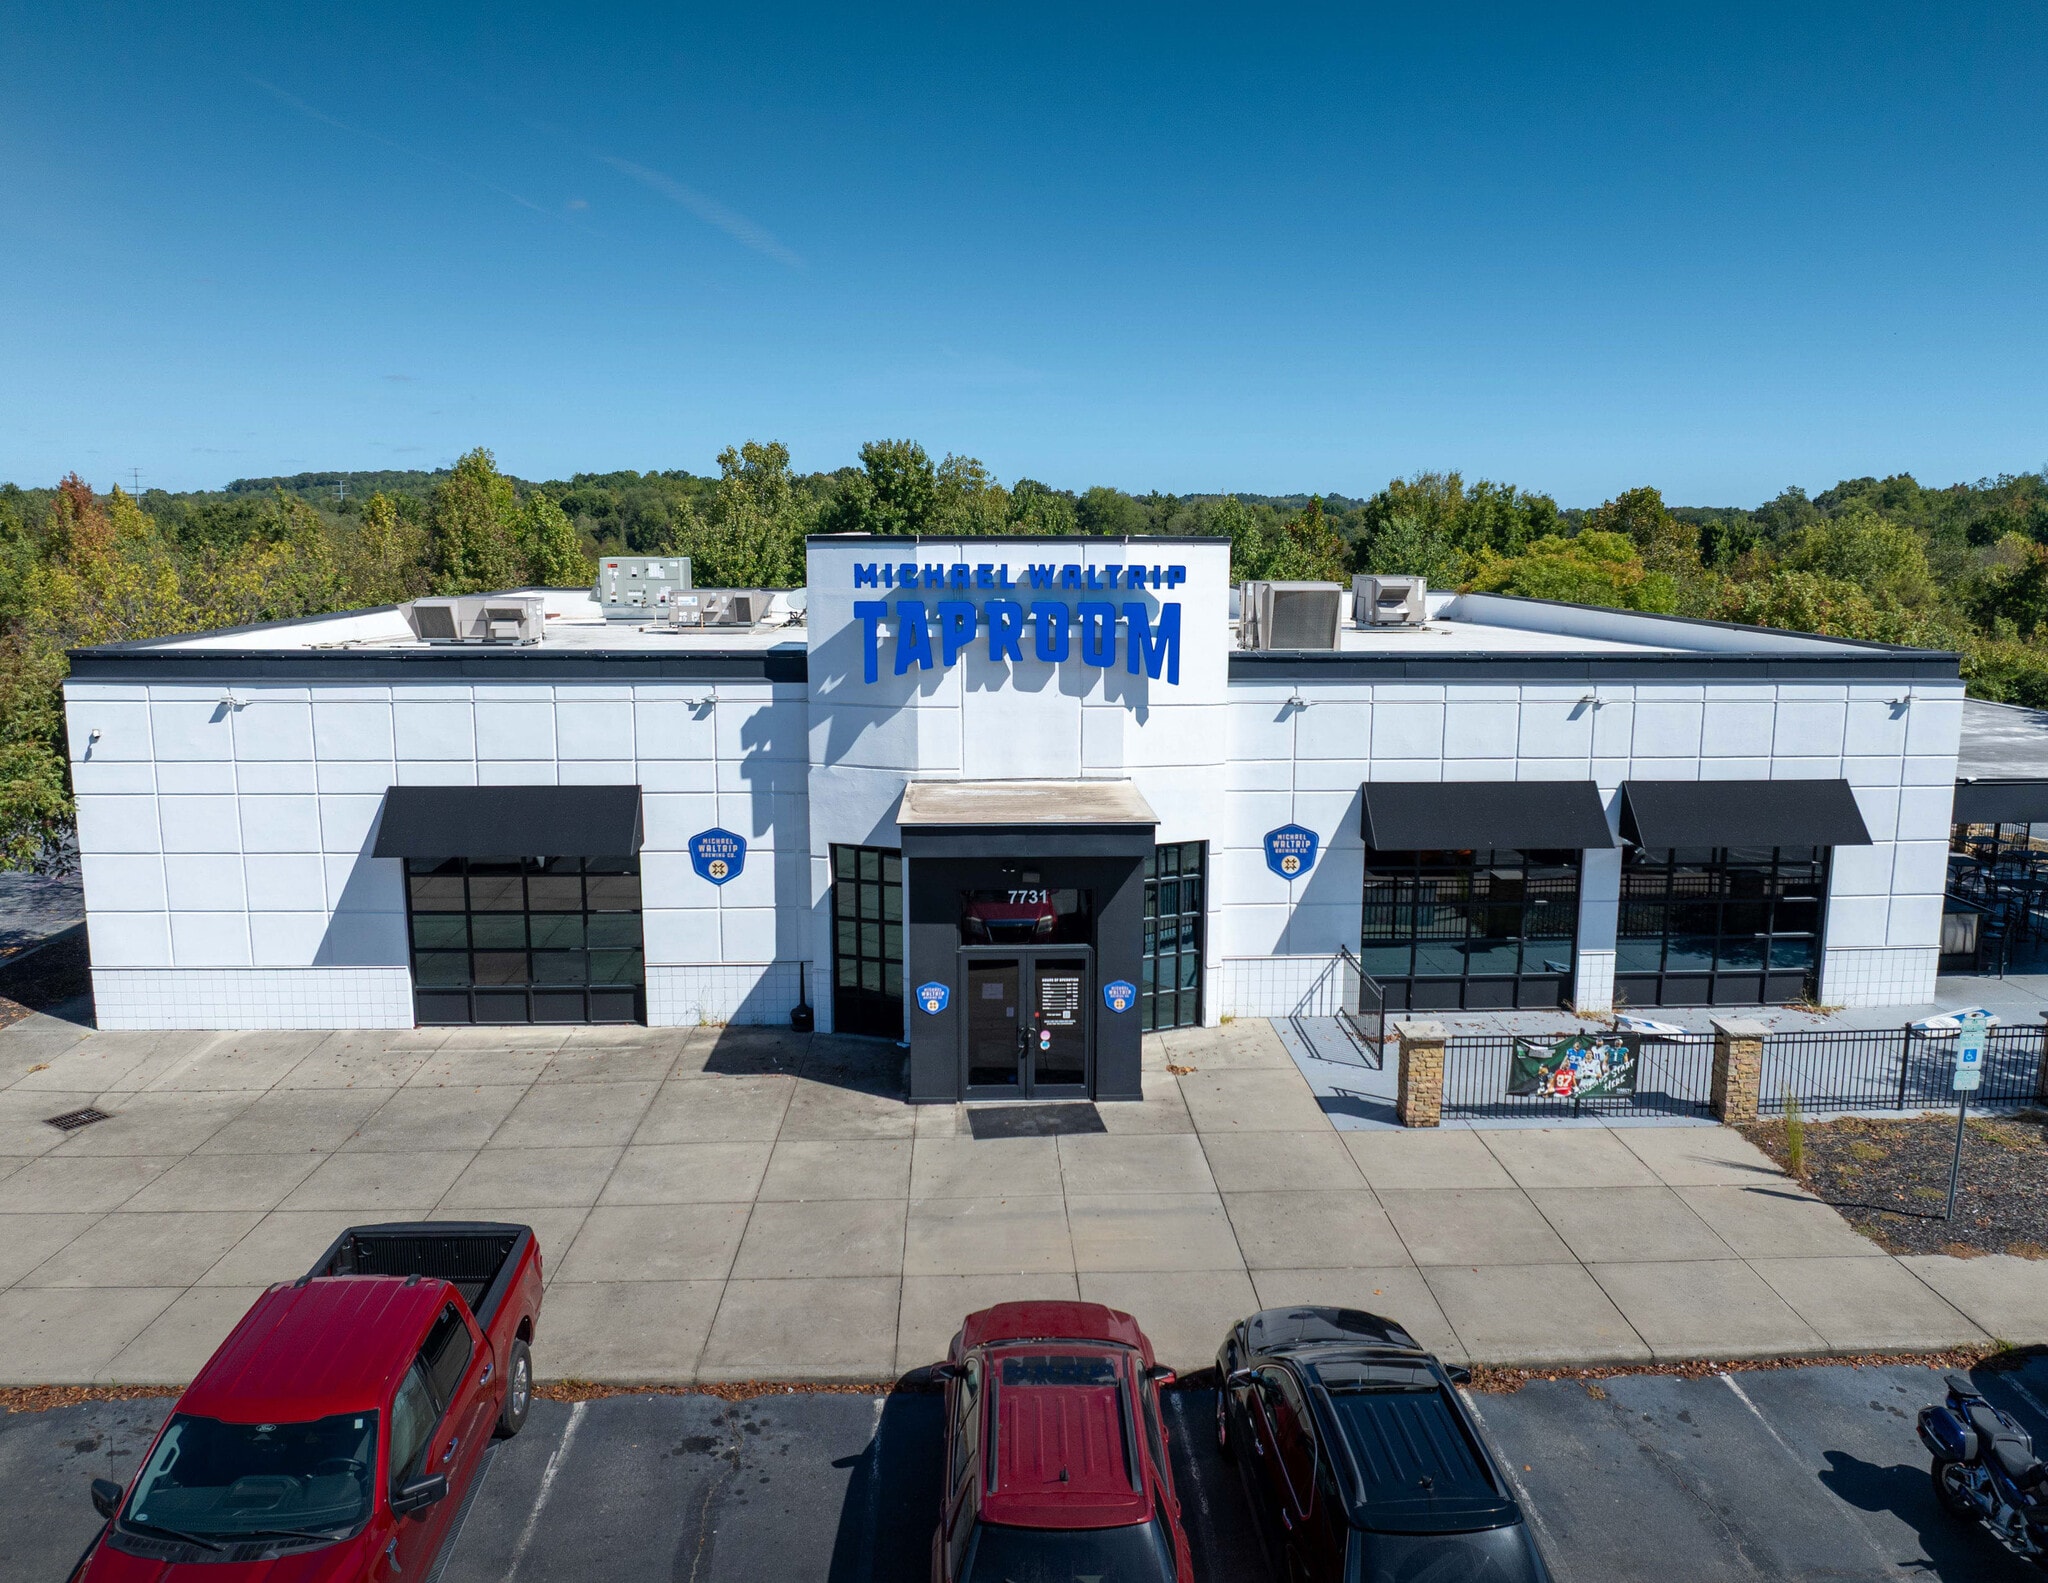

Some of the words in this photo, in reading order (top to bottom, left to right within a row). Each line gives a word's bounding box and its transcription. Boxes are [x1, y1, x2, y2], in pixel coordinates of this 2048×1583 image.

[854, 563, 1016, 589] MICHAEL
[1028, 564, 1187, 590] WALTRIP
[853, 600, 1181, 686] TAPROOM
[1008, 890, 1047, 904] 7731
[1556, 1074, 1572, 1087] 87
